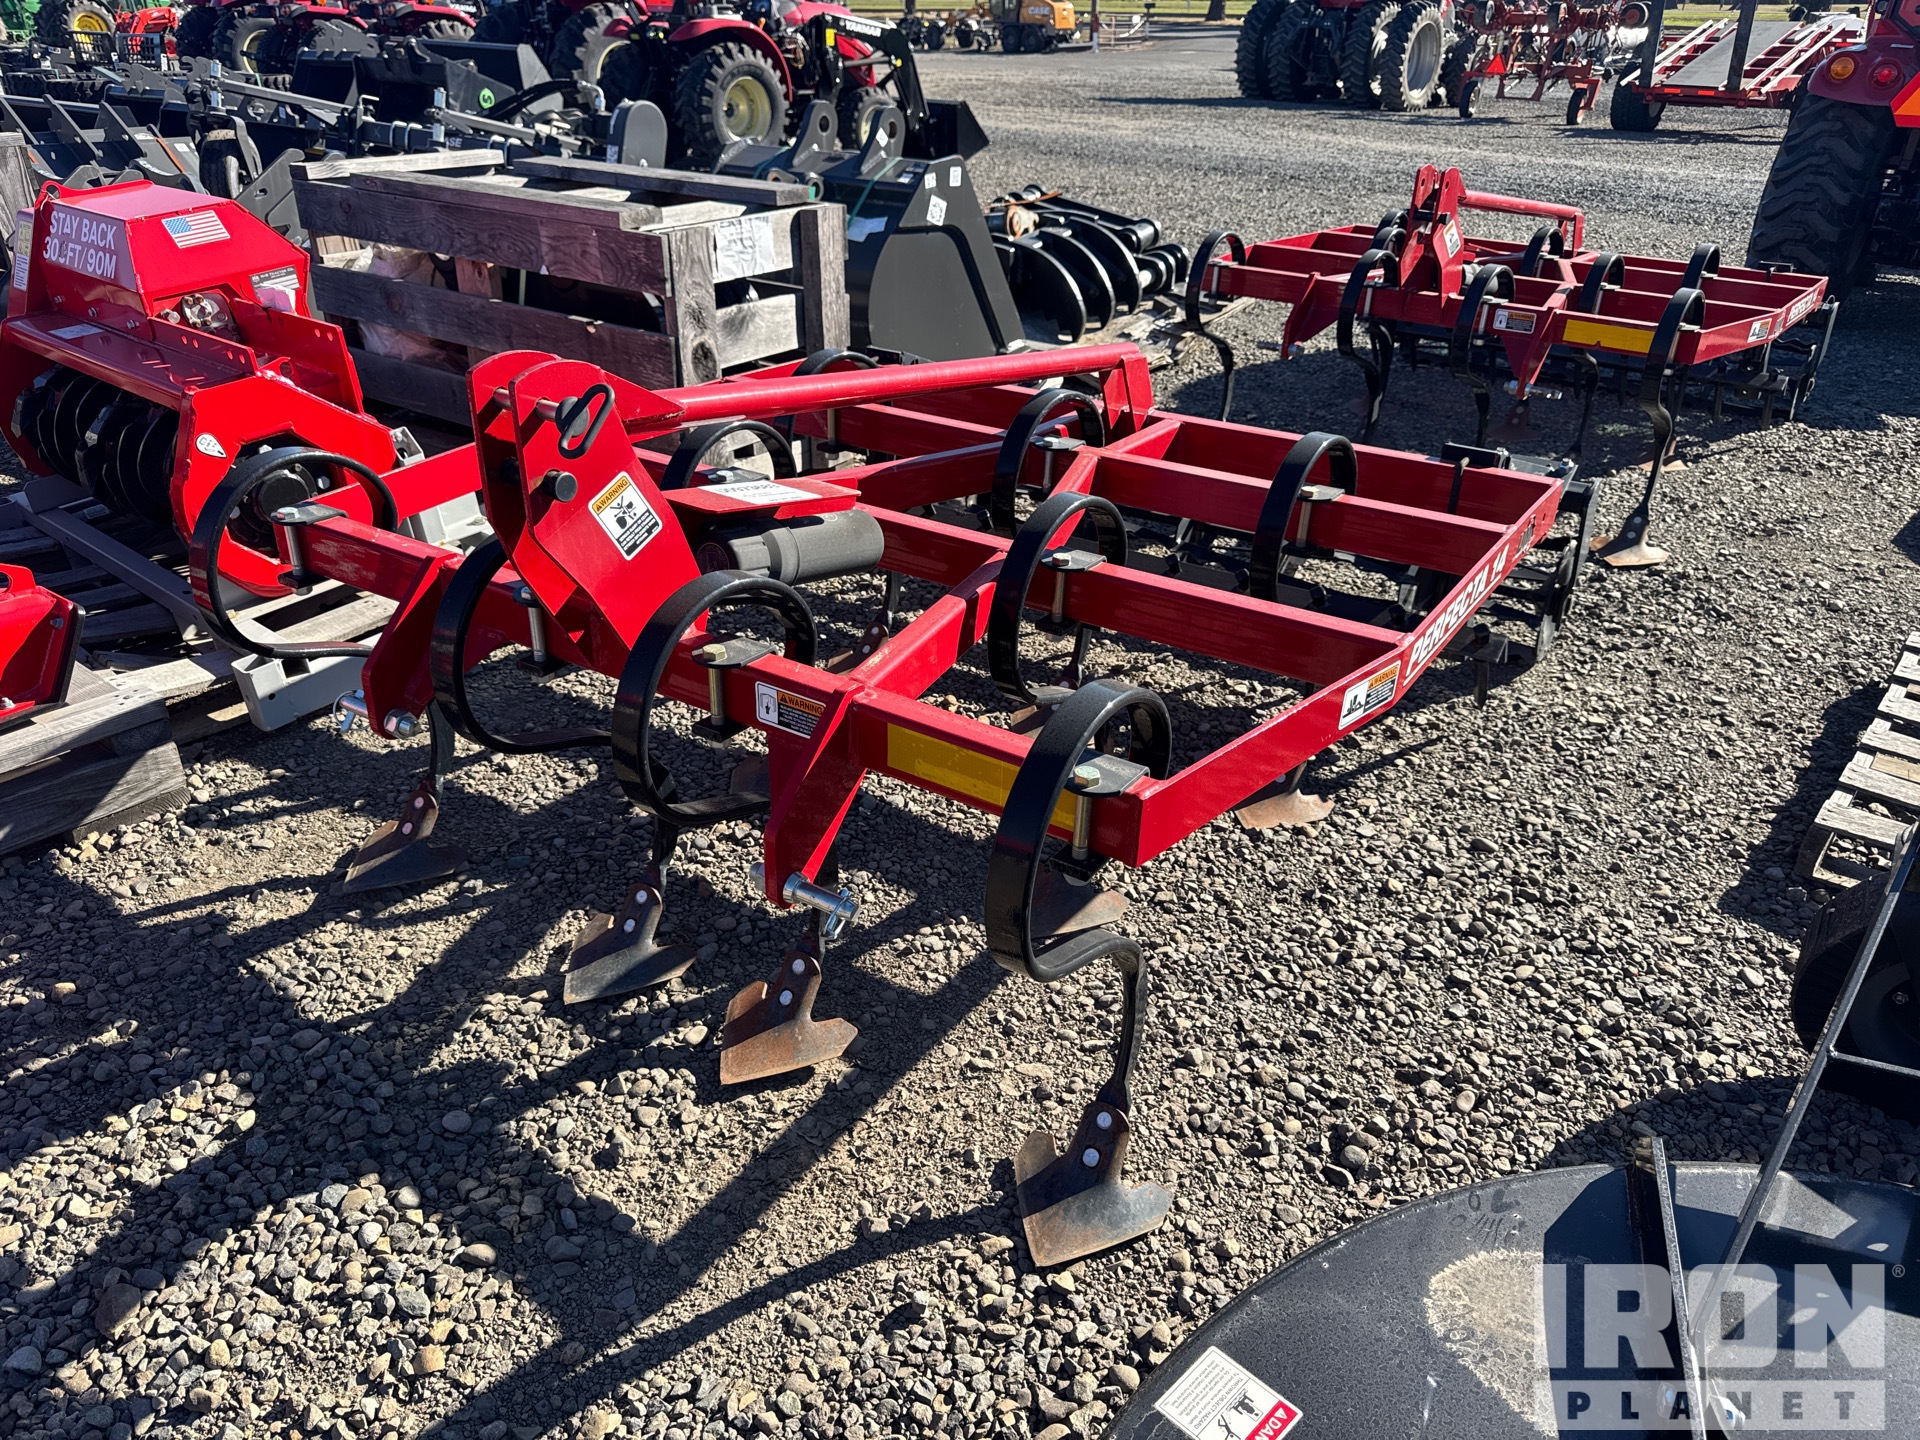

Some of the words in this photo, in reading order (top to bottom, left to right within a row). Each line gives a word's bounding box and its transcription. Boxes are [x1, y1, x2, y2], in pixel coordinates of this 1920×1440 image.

[845, 20, 882, 38] YANMAR
[50, 211, 79, 239] STAY
[80, 218, 117, 250] BACK
[600, 480, 628, 507] WARNING
[1405, 564, 1490, 677] PERFECTA
[1490, 543, 1510, 582] 14
[787, 696, 824, 714] WARNING
[1224, 1376, 1243, 1395] THROWN
[1209, 1393, 1227, 1412] OBJECT
[1193, 1410, 1211, 1429] HAZARD
